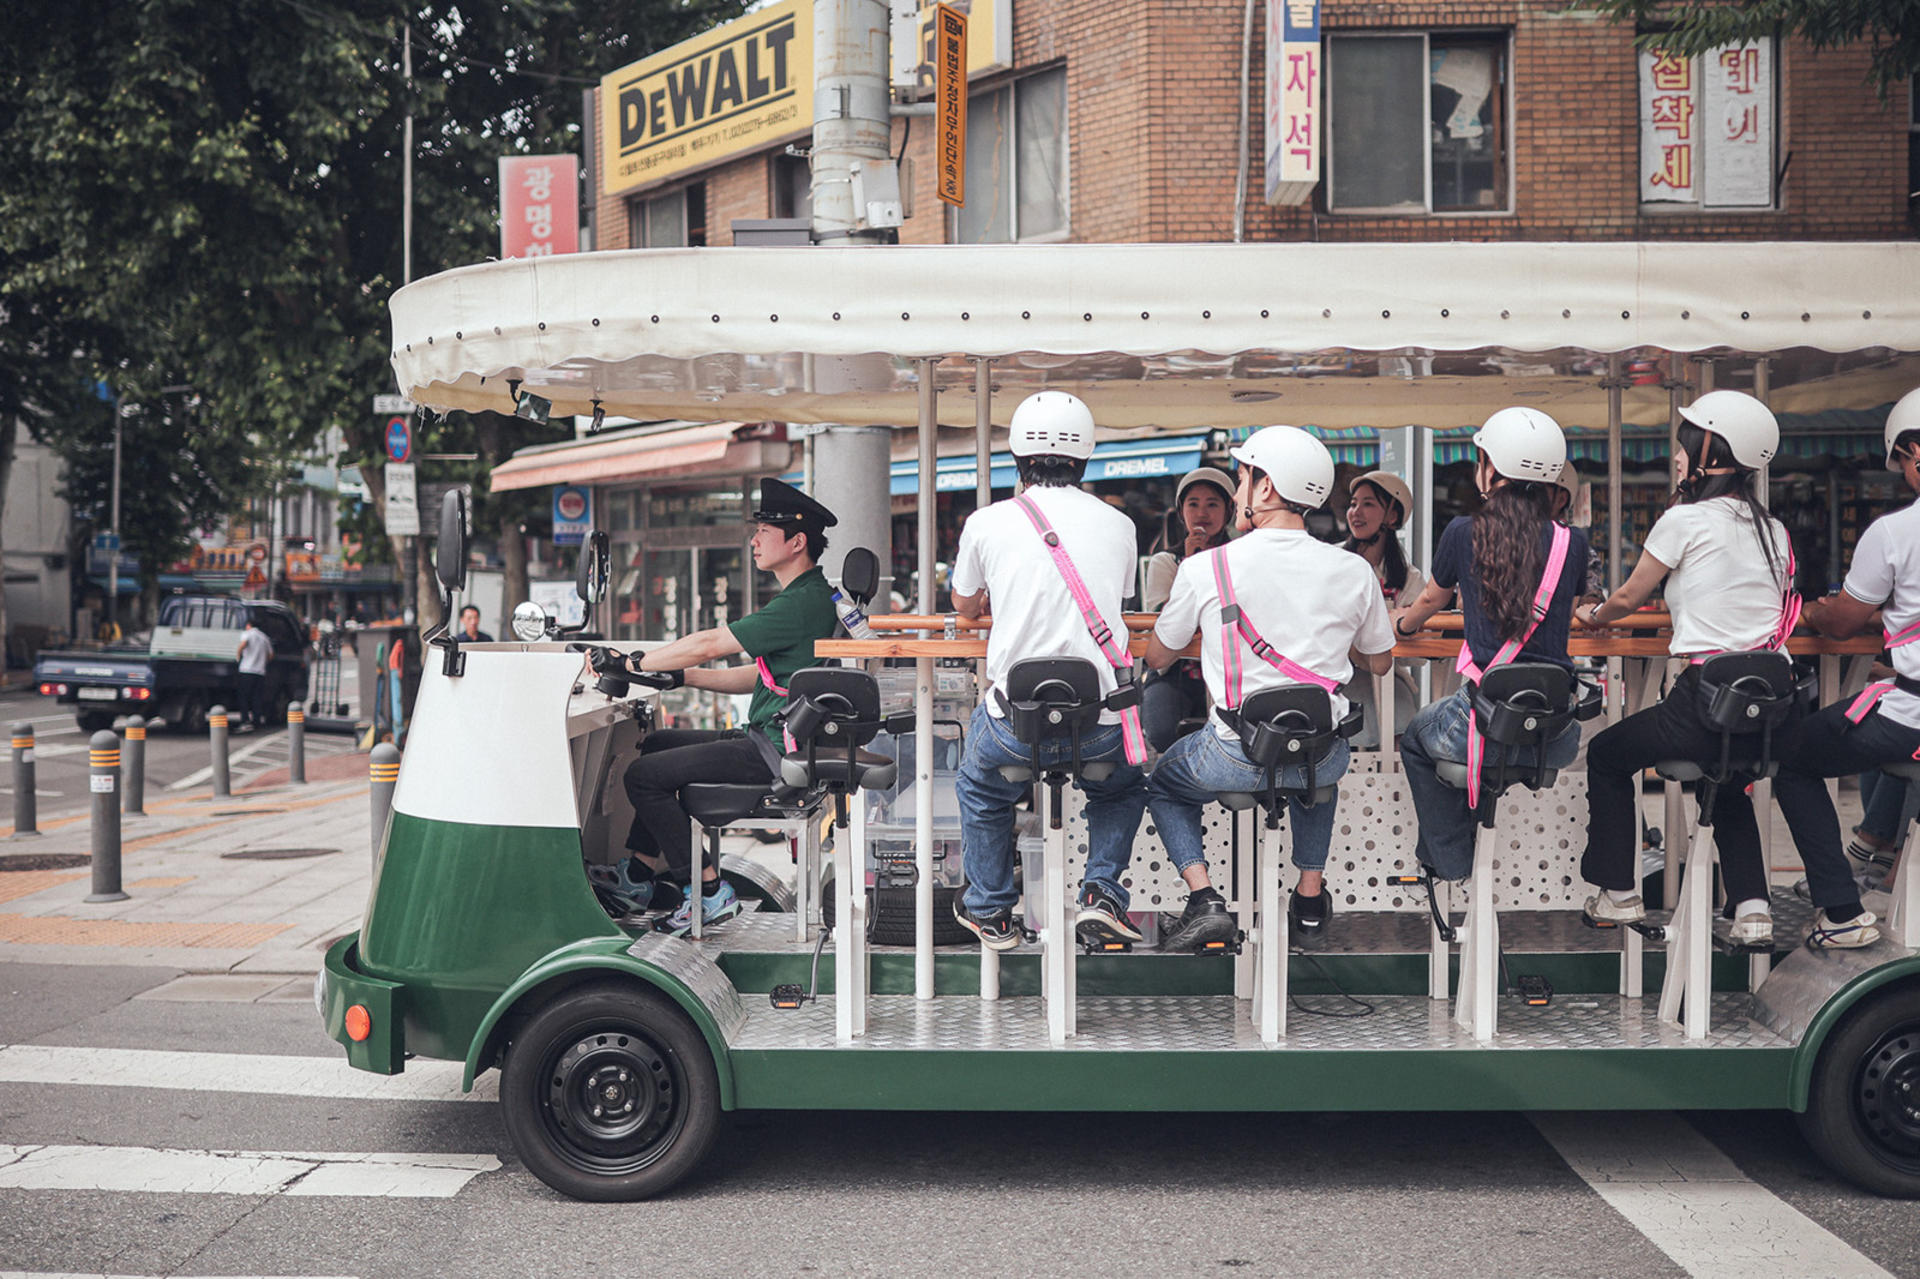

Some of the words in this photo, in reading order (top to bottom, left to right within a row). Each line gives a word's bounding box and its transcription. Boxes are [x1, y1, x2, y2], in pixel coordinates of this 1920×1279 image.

[619, 22, 795, 149] DEWALT
[1286, 51, 1317, 170] 자석
[1651, 48, 1694, 188] 접착제
[1719, 48, 1759, 190] 테이
[1104, 457, 1168, 477] DREMEL
